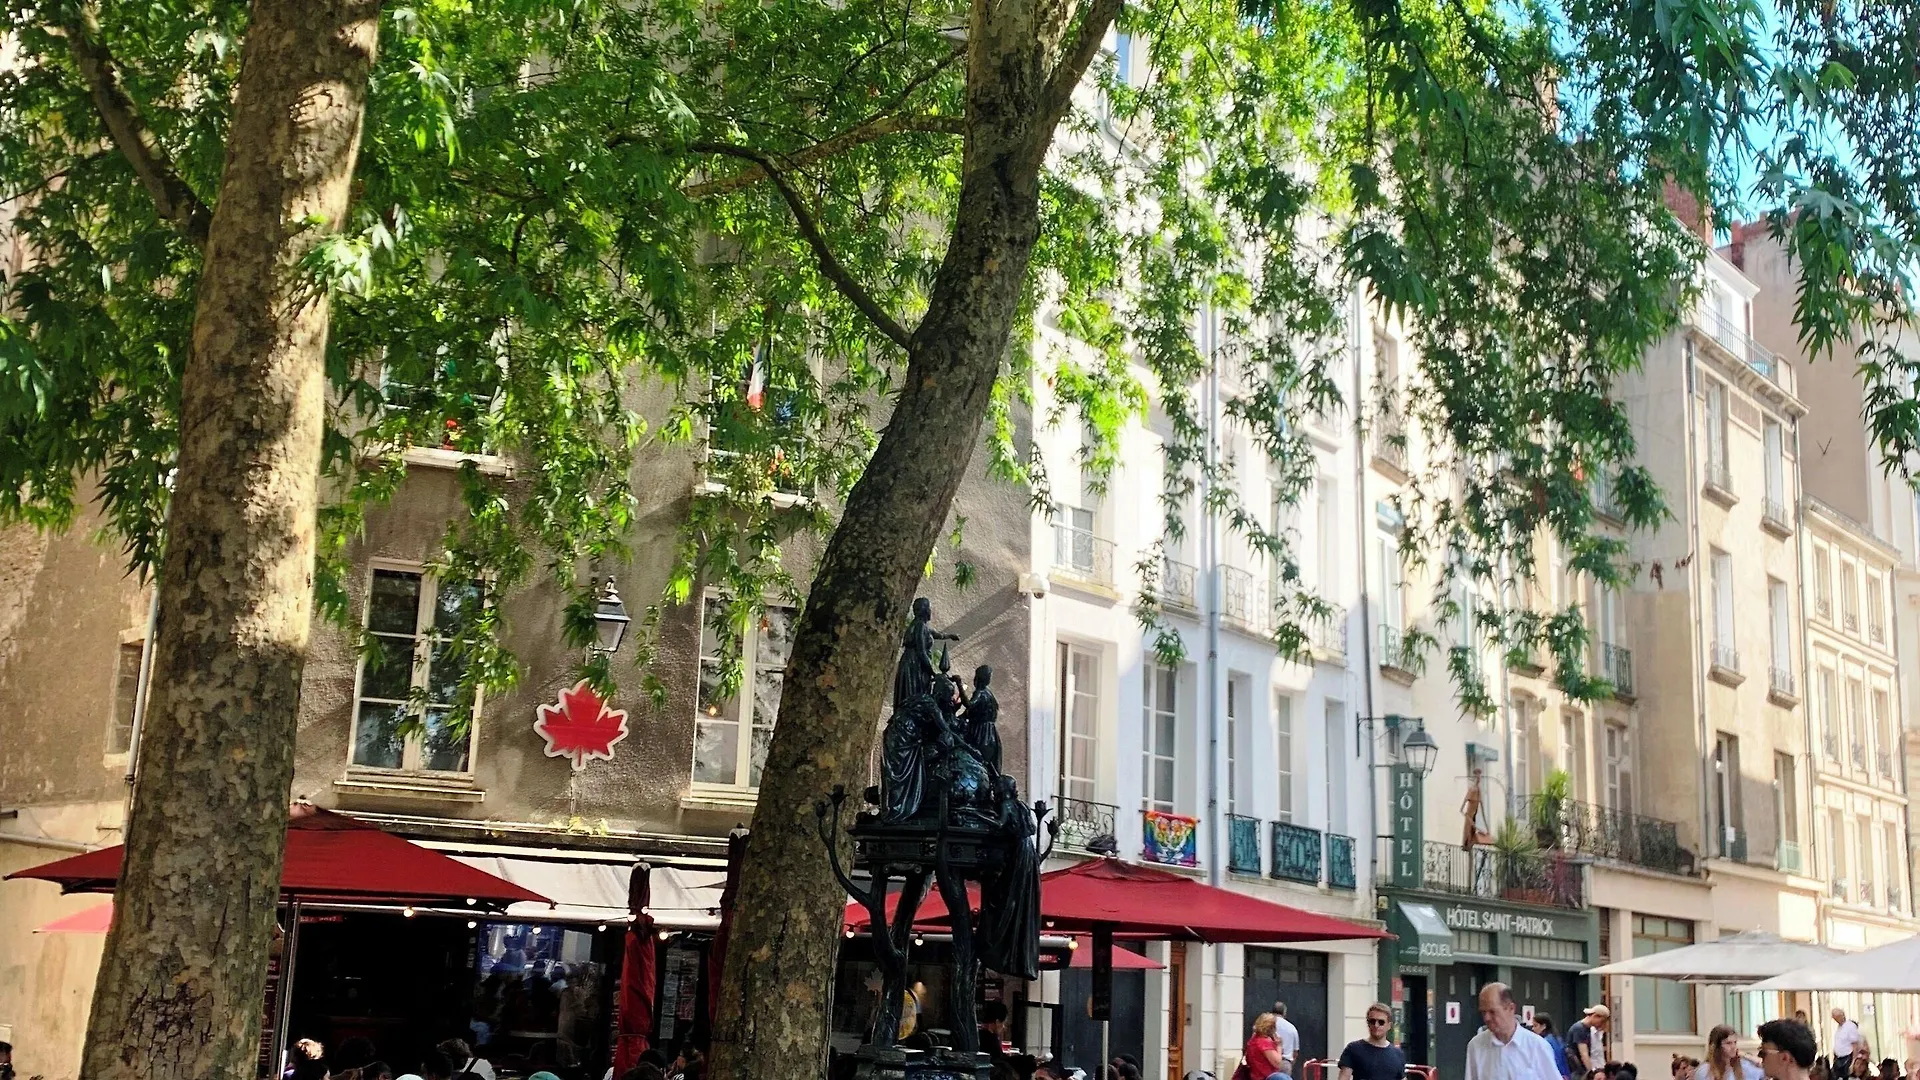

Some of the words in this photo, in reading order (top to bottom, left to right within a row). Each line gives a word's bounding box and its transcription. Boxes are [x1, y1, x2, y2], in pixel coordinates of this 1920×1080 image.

[1399, 772, 1413, 877] HÔTEL
[1446, 903, 1481, 928] HÔTEL
[1482, 911, 1554, 936] SAINT-PATRICK
[1419, 942, 1453, 957] ACCUEIL
